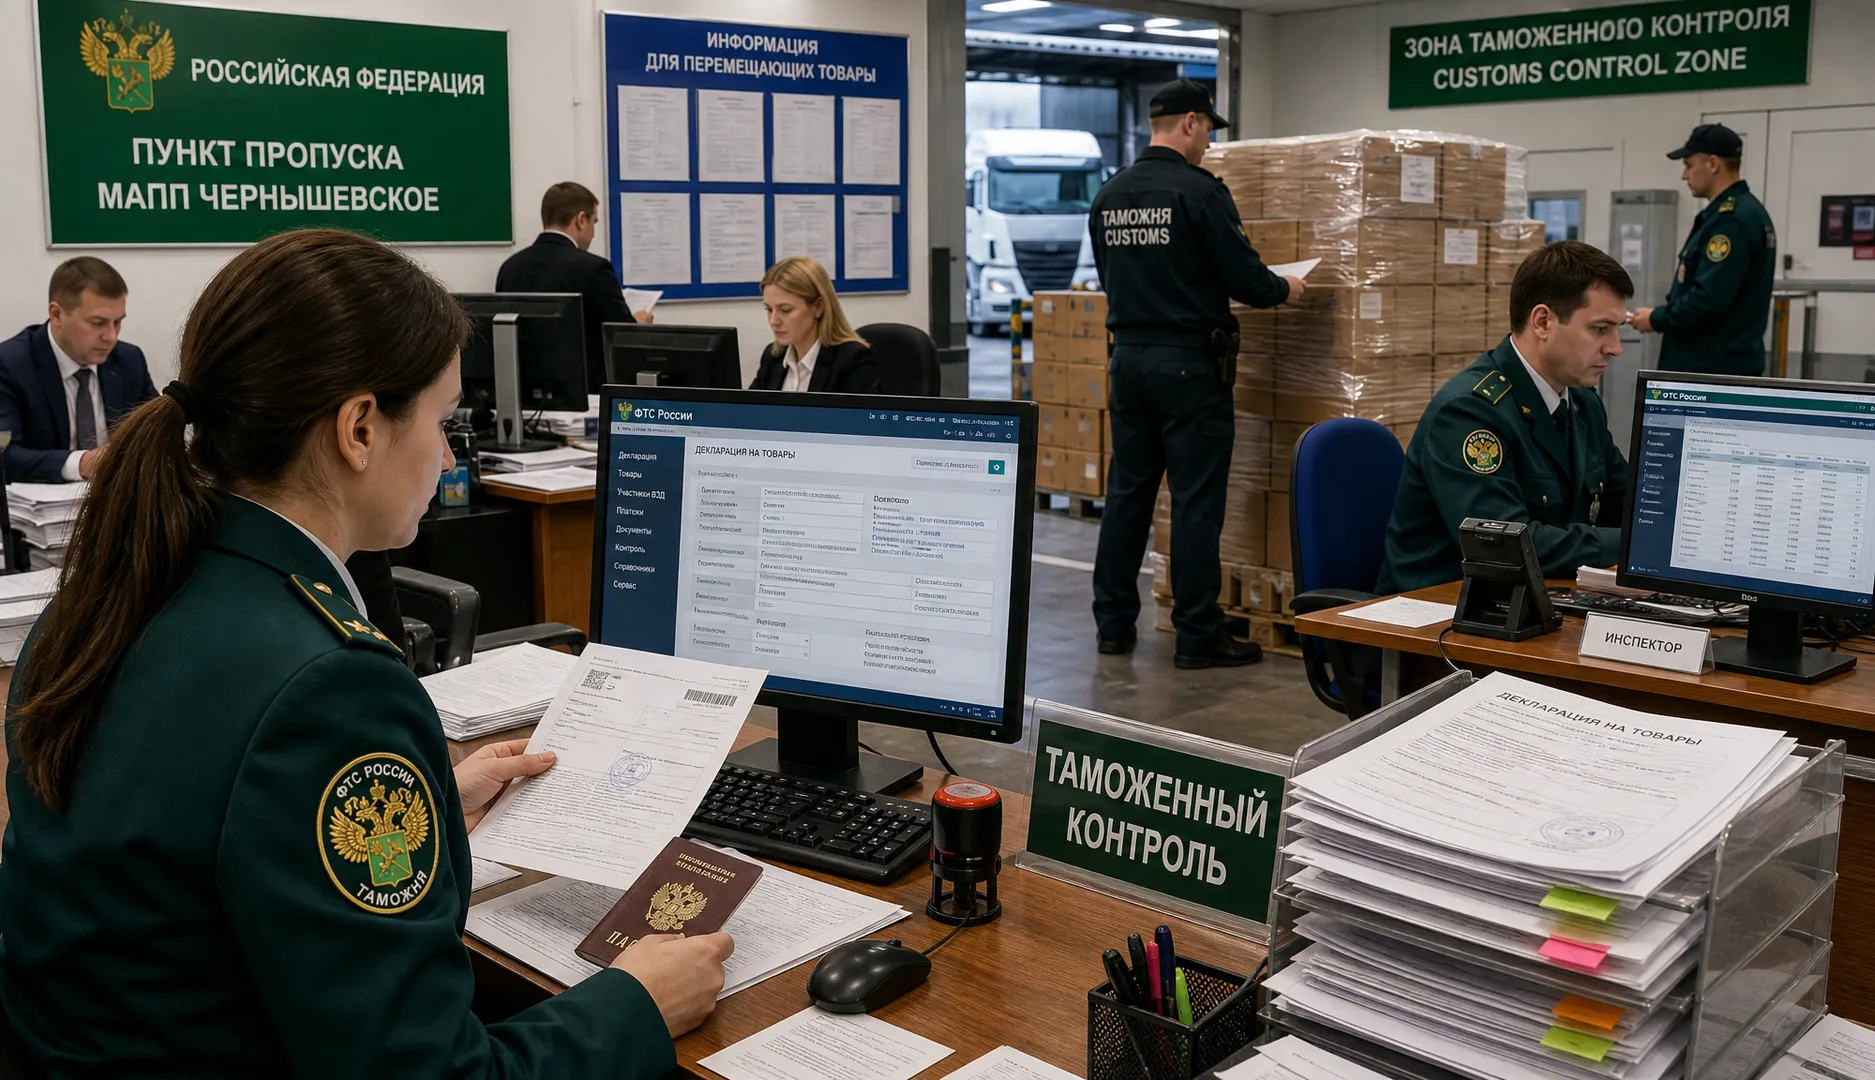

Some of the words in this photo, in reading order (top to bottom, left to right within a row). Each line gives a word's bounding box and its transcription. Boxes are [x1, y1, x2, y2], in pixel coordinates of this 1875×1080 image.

[707, 31, 818, 57] ИНФОРМАЦИЯ
[1404, 36, 1463, 60] ЗОНА
[1469, 17, 1643, 54] ТАМОЖЕННОГО
[1651, 5, 1790, 38] КОНТРОЛЯ
[191, 57, 351, 88] РОССИЙСКАЯ
[356, 67, 485, 98] ФЕДЕРАЦИЯ
[645, 52, 680, 73] ДЛЯ
[684, 55, 815, 81] ПЕРЕМЕЩАЮЩИХ
[818, 64, 876, 83] ТОВАРЫ
[1433, 61, 1543, 91] CUSTOMS
[1549, 53, 1668, 83] CONTROL
[1676, 47, 1747, 75] ZONE
[132, 137, 236, 167] ПУНКТ
[245, 140, 404, 171] ПРОПУСКА
[97, 182, 189, 210] МАПП
[199, 184, 440, 212] ЧЕРНЫШЕВСКОЕ
[1101, 207, 1173, 227] ТАМОЖНЯ
[1105, 227, 1170, 247] CUSTOMS
[634, 407, 655, 419] ФТС
[658, 409, 693, 422] России
[695, 445, 748, 457] ДЕКЛАРАЦИЯ
[749, 448, 760, 458] НА
[762, 448, 796, 460] ТОВАРЫ
[617, 469, 642, 480] Товары
[615, 525, 652, 535] Документы
[615, 543, 646, 554] Контроль
[1605, 632, 1683, 655] ИНСПЕКТОР
[1496, 691, 1601, 727] ДЕКЛАРАЦИЯ
[1604, 721, 1626, 733] НА
[1632, 727, 1703, 746] ТОВАРЫ
[336, 772, 362, 798] ФТС
[364, 763, 415, 789] РОССИИ
[1045, 746, 1269, 838] ТАМОЖЕННЫЙ
[1066, 806, 1227, 886] КОНТРОЛЬ
[355, 870, 428, 906] ТАМОЖНЯ
